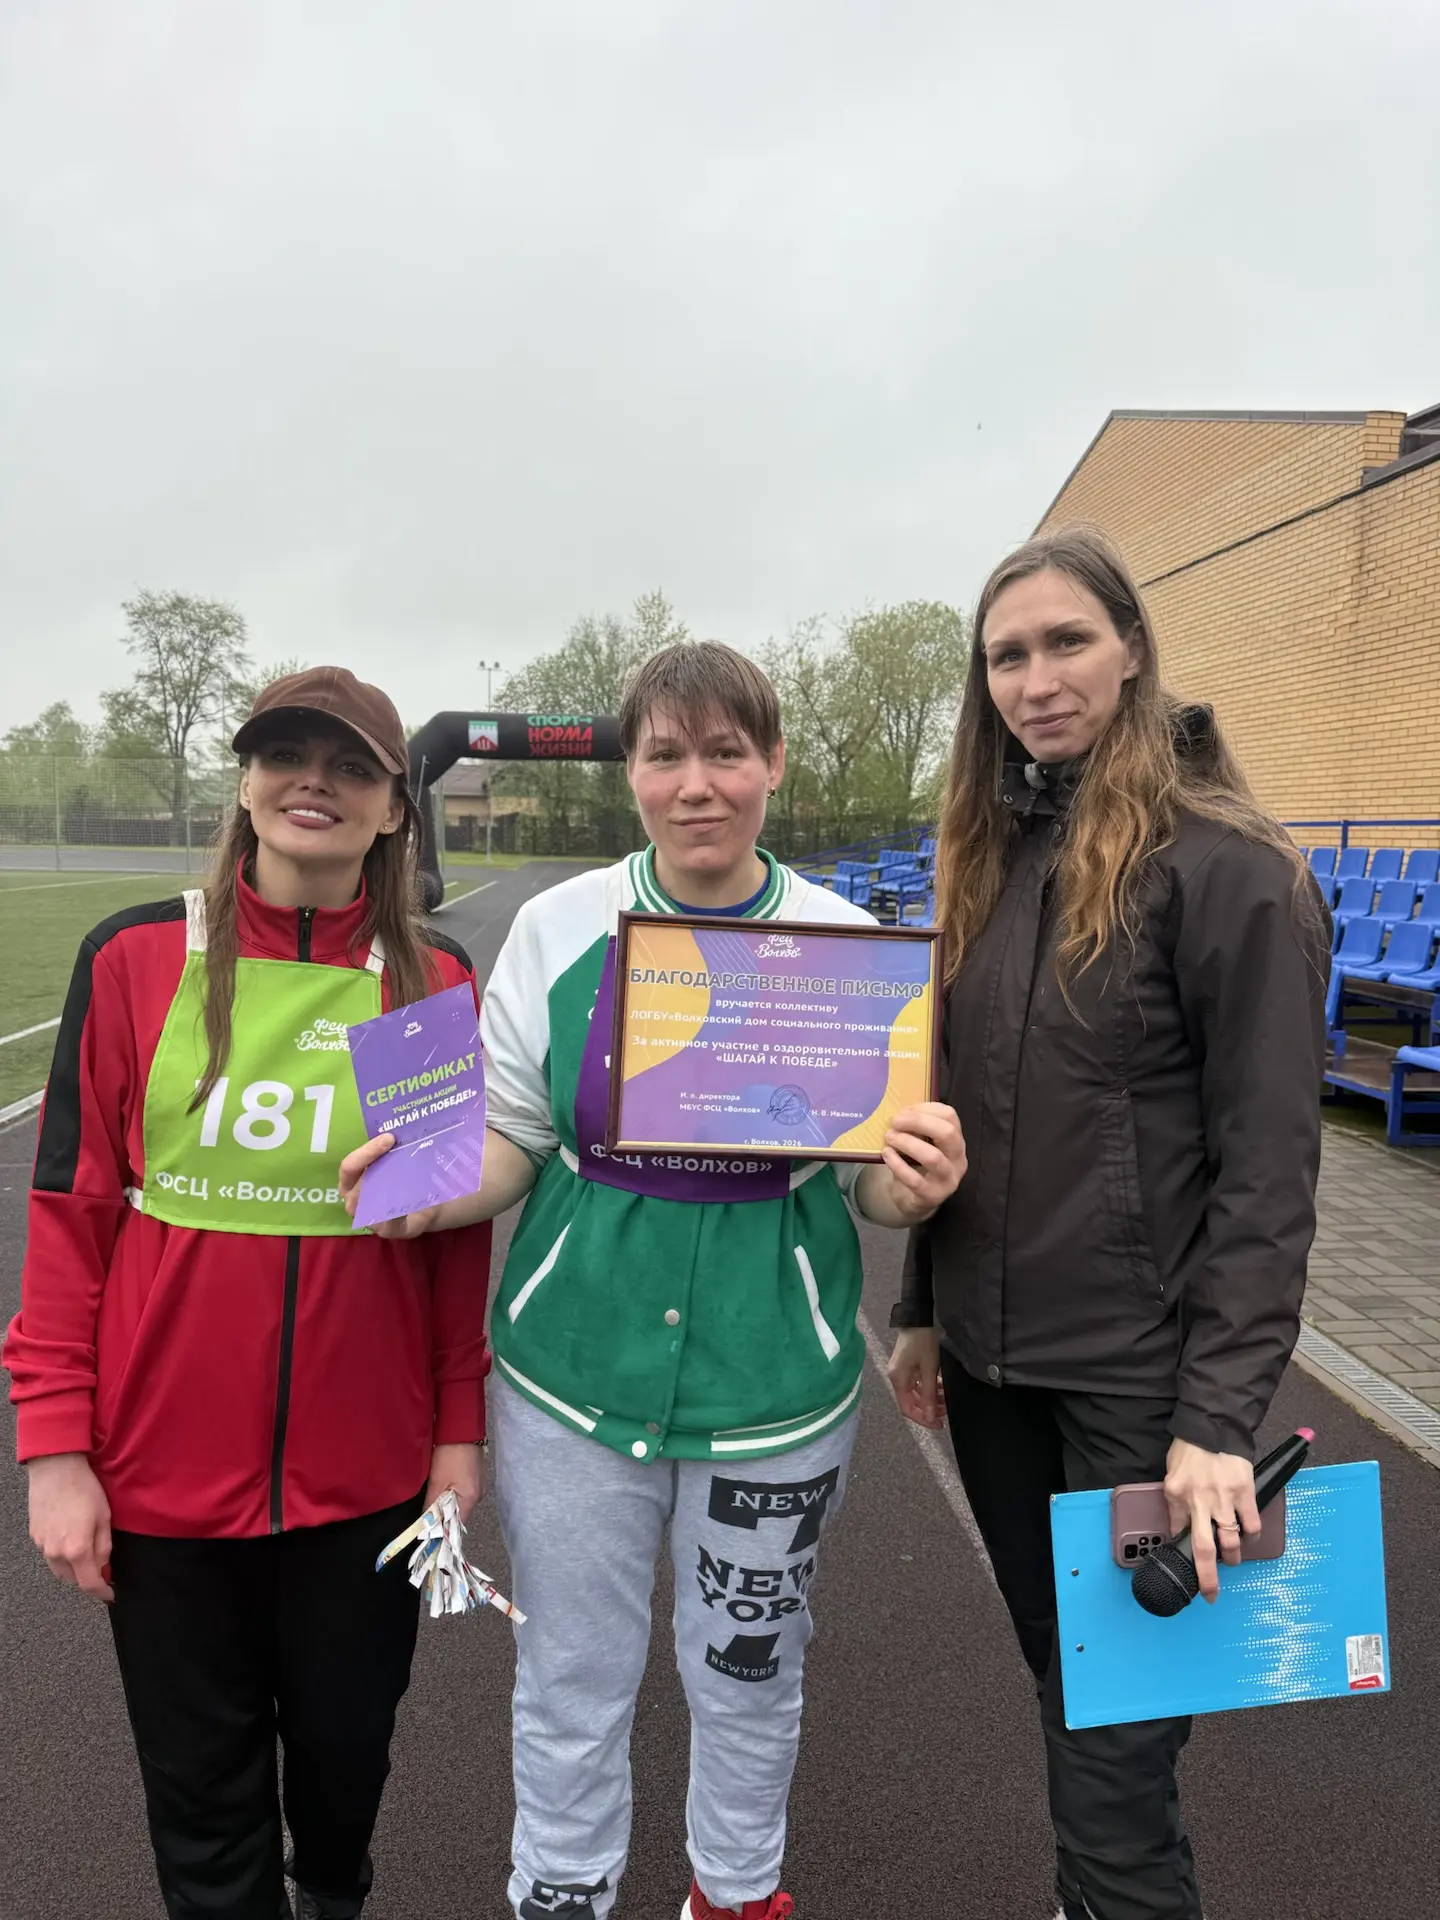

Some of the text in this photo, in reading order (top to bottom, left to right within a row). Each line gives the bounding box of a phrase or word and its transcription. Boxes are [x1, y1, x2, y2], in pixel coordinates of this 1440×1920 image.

[527, 715, 580, 726] СПОРТ
[527, 726, 593, 742] НОРМА
[529, 742, 592, 756] ЖИЗНИ
[630, 968, 924, 999] БЛАГОДАРСТВЕННОЕ ПИСЬМО
[715, 999, 839, 1014] вручается коллективу
[744, 1018, 768, 1027] дом
[770, 1018, 841, 1030] социального
[844, 1023, 919, 1034] проживания»
[632, 1035, 921, 1060] За активное участие в оздоровительной акции
[715, 1053, 838, 1069] «ШАГАЙ К ПОБЕДЕ»
[366, 1052, 476, 1107] СЕРТИФИКАТ
[392, 1084, 458, 1114] УЧАСТНИКА АКЦИИ
[699, 1093, 741, 1102] директора
[195, 1076, 336, 1153] 181
[703, 1105, 722, 1113] ФСЦ
[830, 1110, 864, 1119] Иванова
[378, 1109, 420, 1134] «ШАГАЙ
[421, 1106, 429, 1118] К
[155, 1171, 345, 1204] ФСЦ «Волхов
[731, 1483, 828, 1510] NEW
[696, 1574, 806, 1623] YOR
